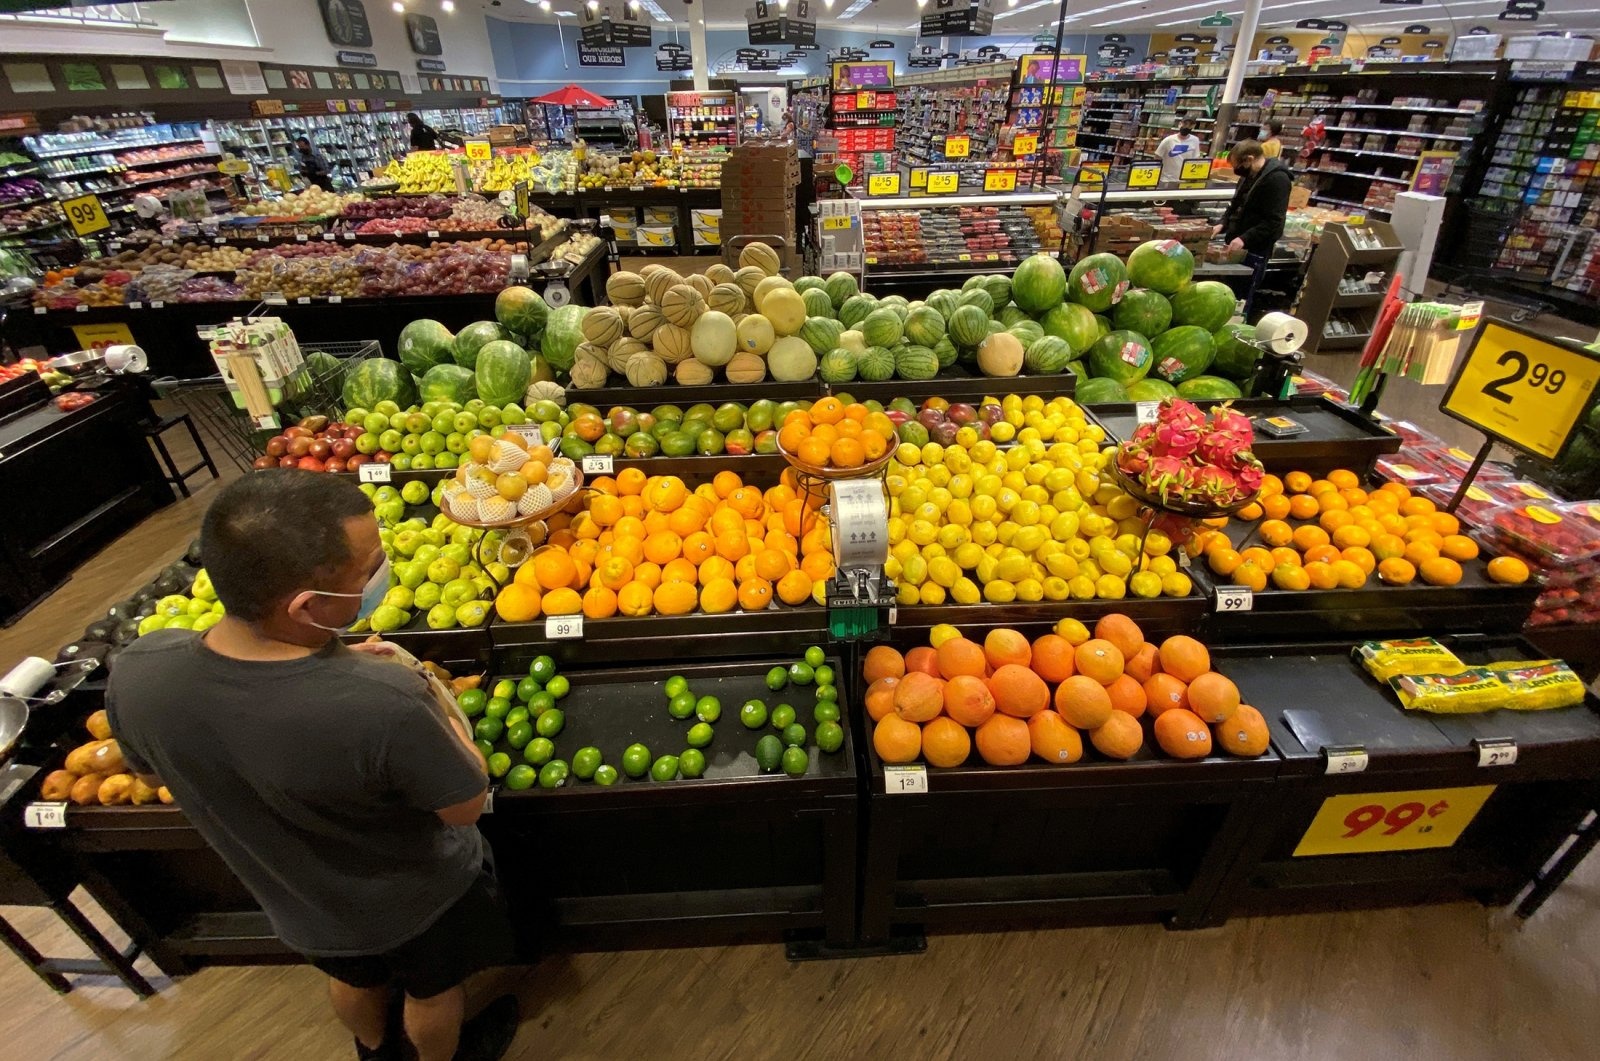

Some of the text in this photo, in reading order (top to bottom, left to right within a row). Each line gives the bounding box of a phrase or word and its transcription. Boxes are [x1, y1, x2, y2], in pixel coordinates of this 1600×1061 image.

[758, 4, 764, 15] 2
[801, 4, 806, 15] 2
[582, 55, 622, 63] OUR HEROES
